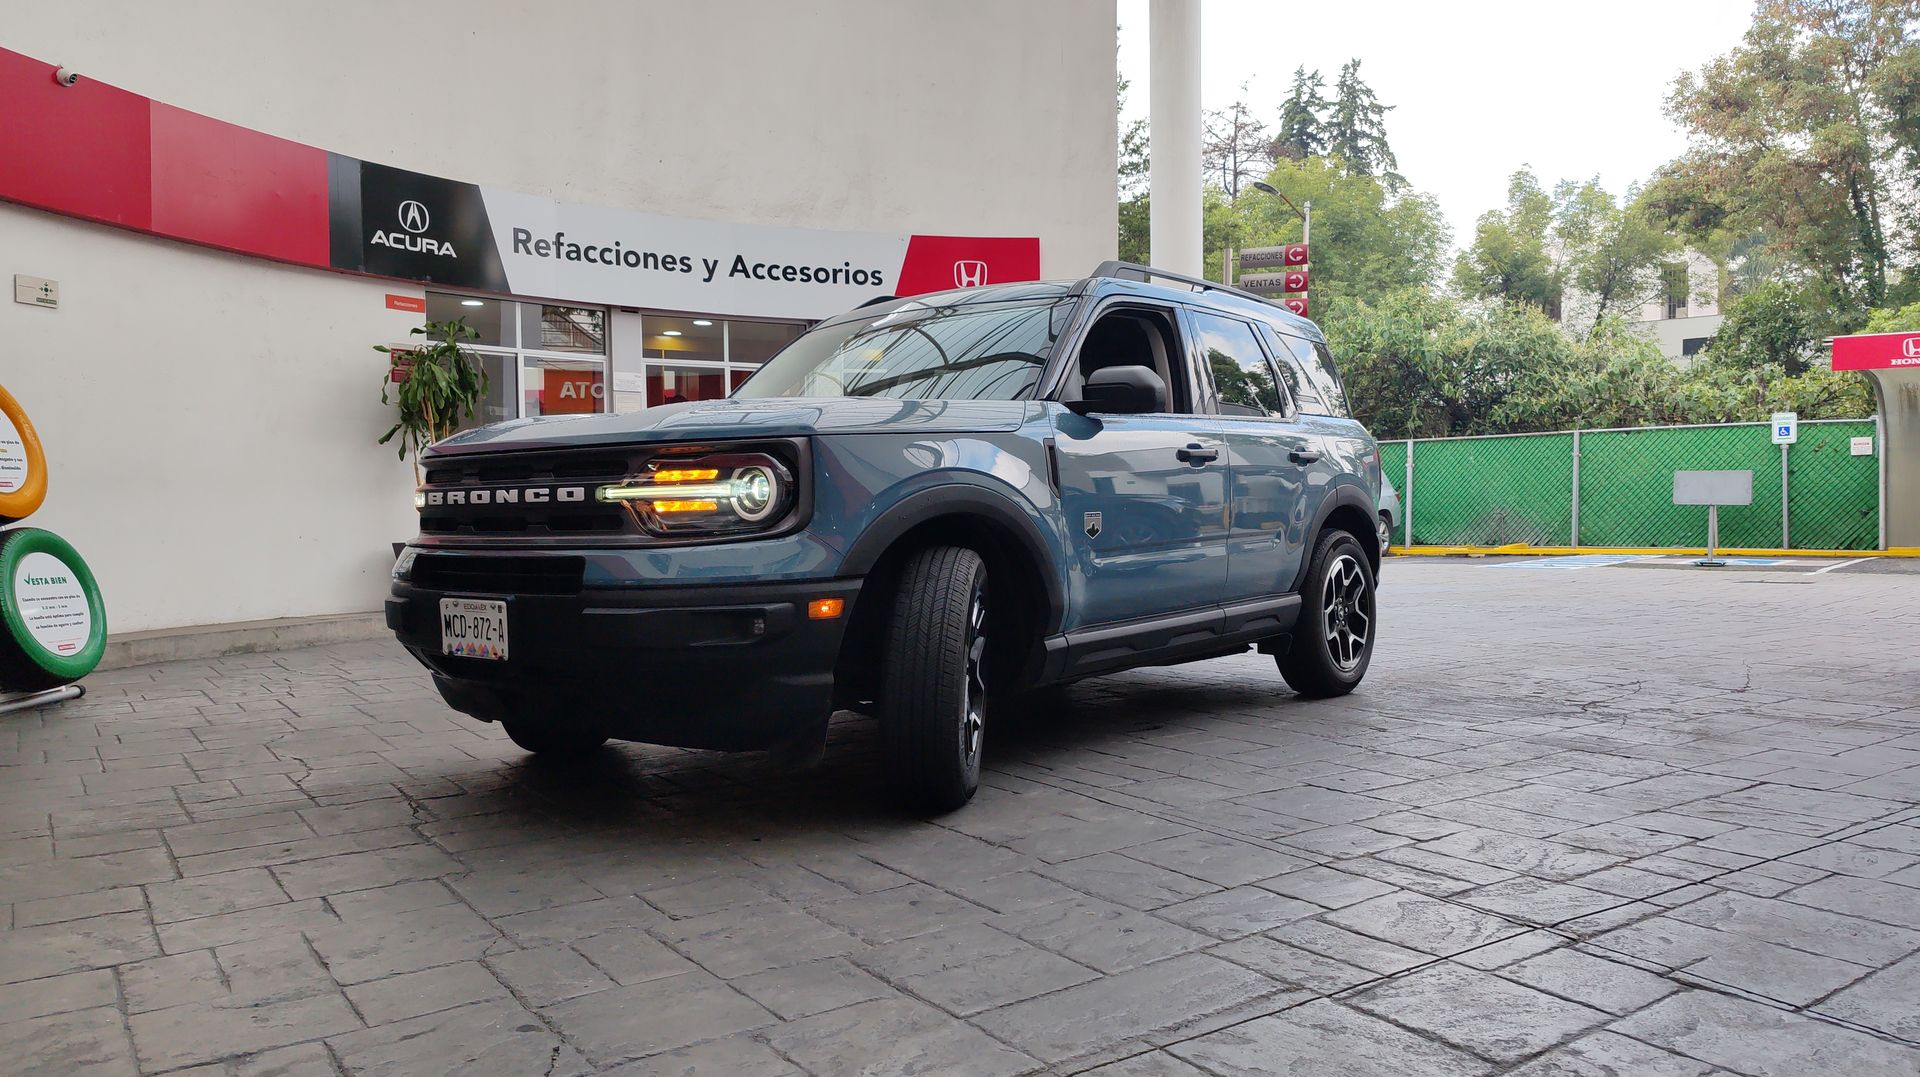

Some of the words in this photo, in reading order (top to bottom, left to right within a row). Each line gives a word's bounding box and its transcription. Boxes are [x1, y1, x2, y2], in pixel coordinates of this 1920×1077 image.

[370, 230, 457, 258] ACURA
[512, 227, 693, 274] Refacciones
[702, 256, 719, 283] y
[728, 254, 884, 287] Accesorios
[1240, 252, 1283, 262] REFACCIONES
[1243, 279, 1281, 288] VENTAS
[428, 487, 585, 505] BRONCO
[50, 576, 67, 585] BIEN
[443, 614, 505, 643] MCD-872-A
